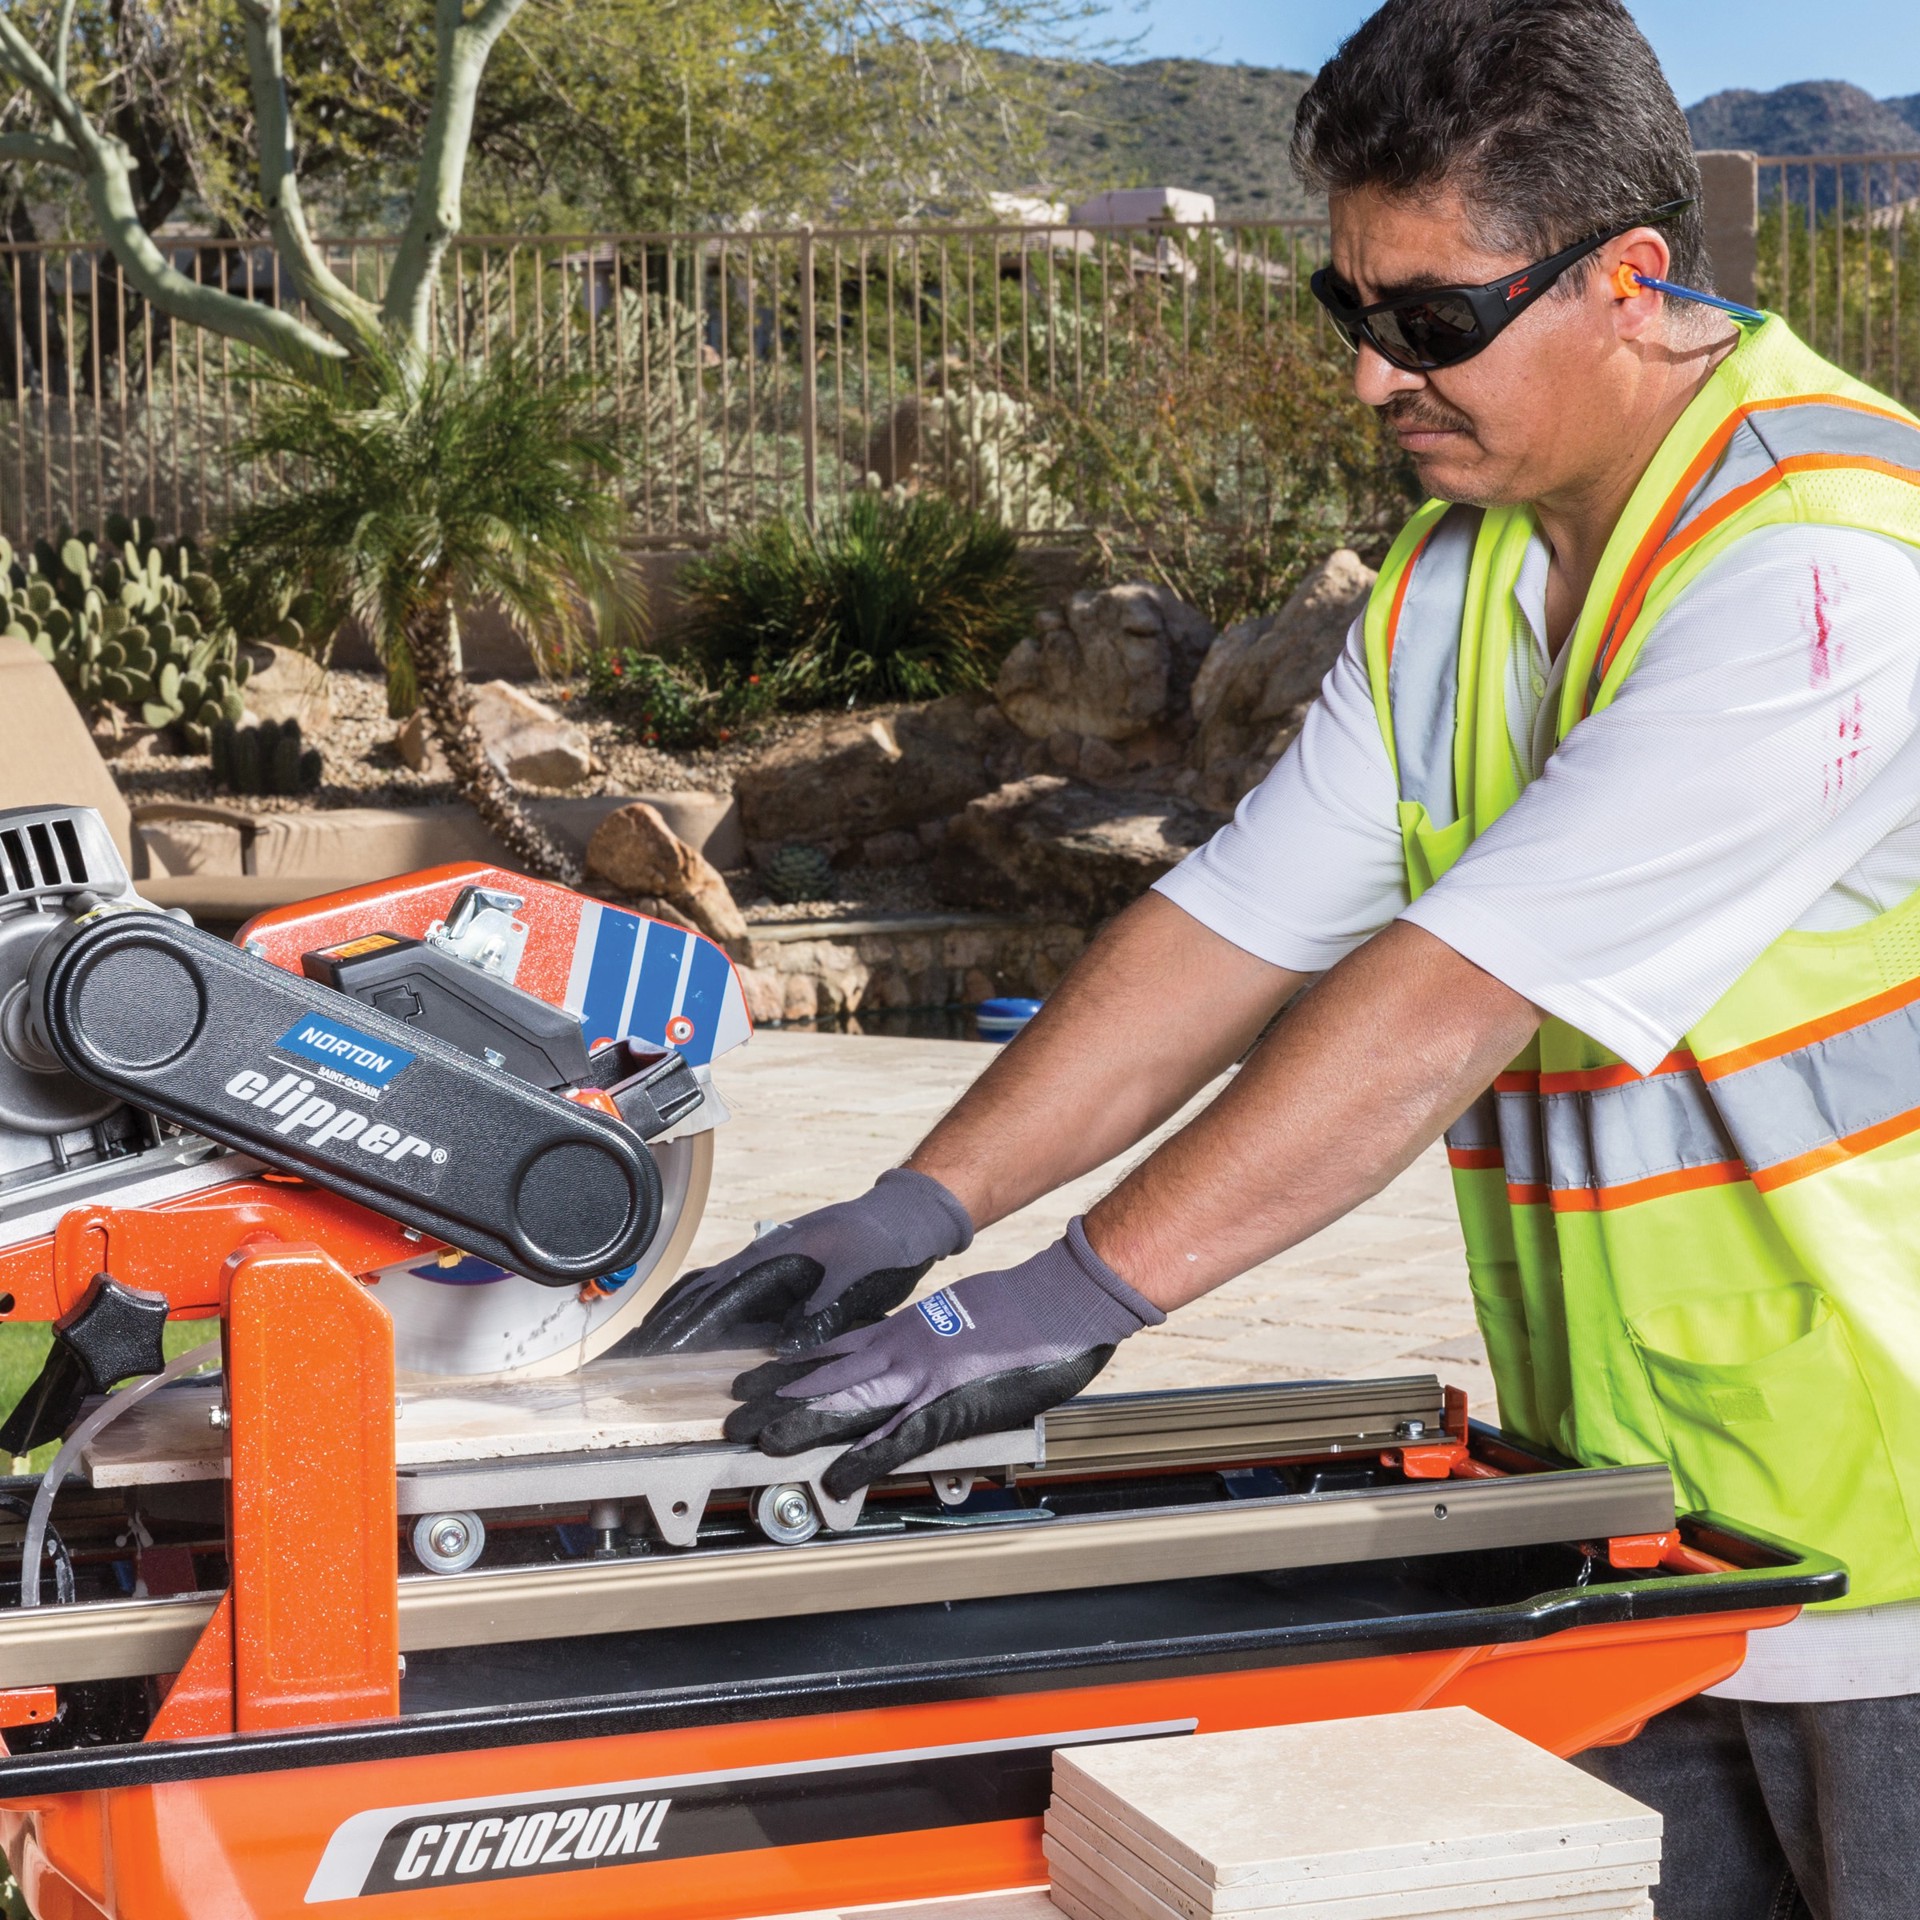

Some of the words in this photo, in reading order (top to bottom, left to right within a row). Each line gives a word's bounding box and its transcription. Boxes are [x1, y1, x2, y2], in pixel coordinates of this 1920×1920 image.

[298, 1027, 393, 1073] NORTON
[317, 1066, 381, 1098] SAINT-GOBAIN
[394, 1799, 672, 1881] CTC1020XL
